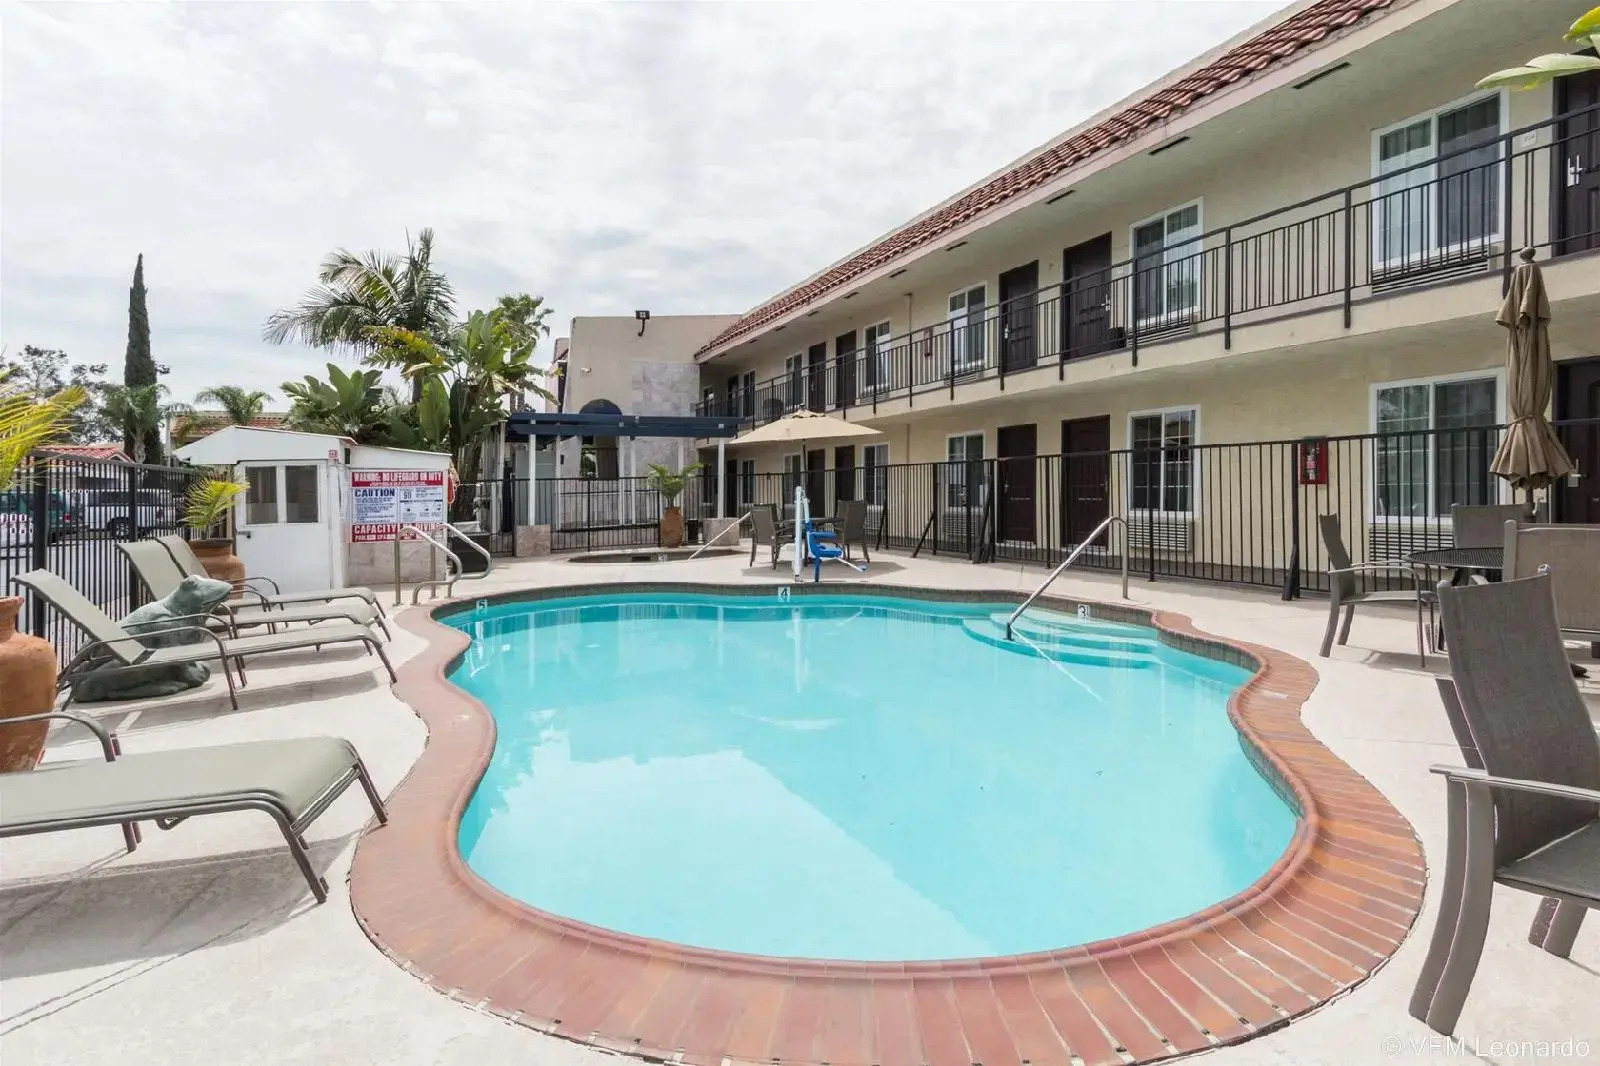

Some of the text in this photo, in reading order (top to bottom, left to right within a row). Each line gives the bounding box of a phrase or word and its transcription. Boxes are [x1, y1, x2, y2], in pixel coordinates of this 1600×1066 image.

[390, 472, 419, 481] LIFEGUARD
[428, 472, 442, 481] DUTY
[354, 488, 395, 497] CAUTION
[403, 491, 412, 499] 911
[354, 523, 397, 535] CAPACITY
[781, 587, 788, 598] 4
[478, 599, 486, 609] 5
[1079, 605, 1086, 617] 3
